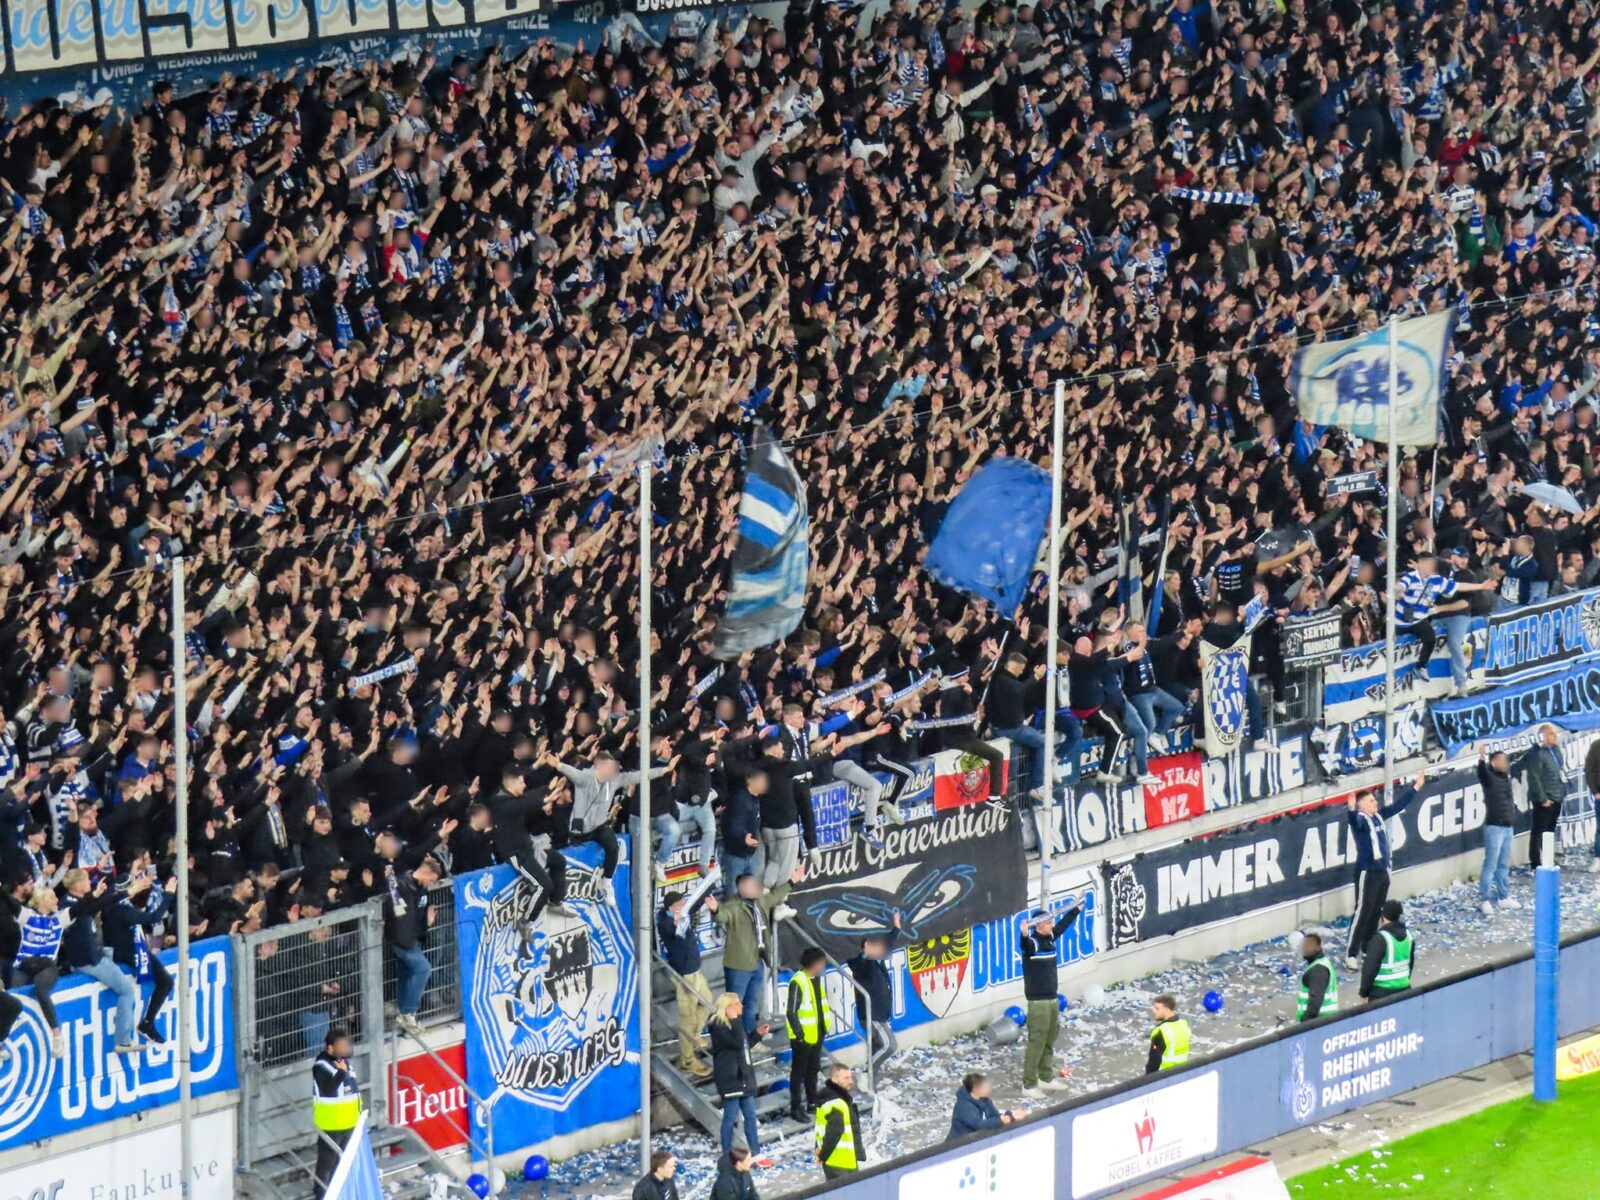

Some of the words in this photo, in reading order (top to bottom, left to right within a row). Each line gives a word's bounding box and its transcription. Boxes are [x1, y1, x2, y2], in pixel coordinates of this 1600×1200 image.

[1161, 793, 1189, 823] MZ
[1156, 838, 1285, 915] IMMER
[1322, 1018, 1397, 1054] OFFIZIELLER
[1322, 1032, 1424, 1081] RHEIN-RUHR-
[1321, 1067, 1392, 1107] PARTNER
[1107, 1157, 1142, 1182] NOBEL
[1146, 1146, 1183, 1169] KAFFEE
